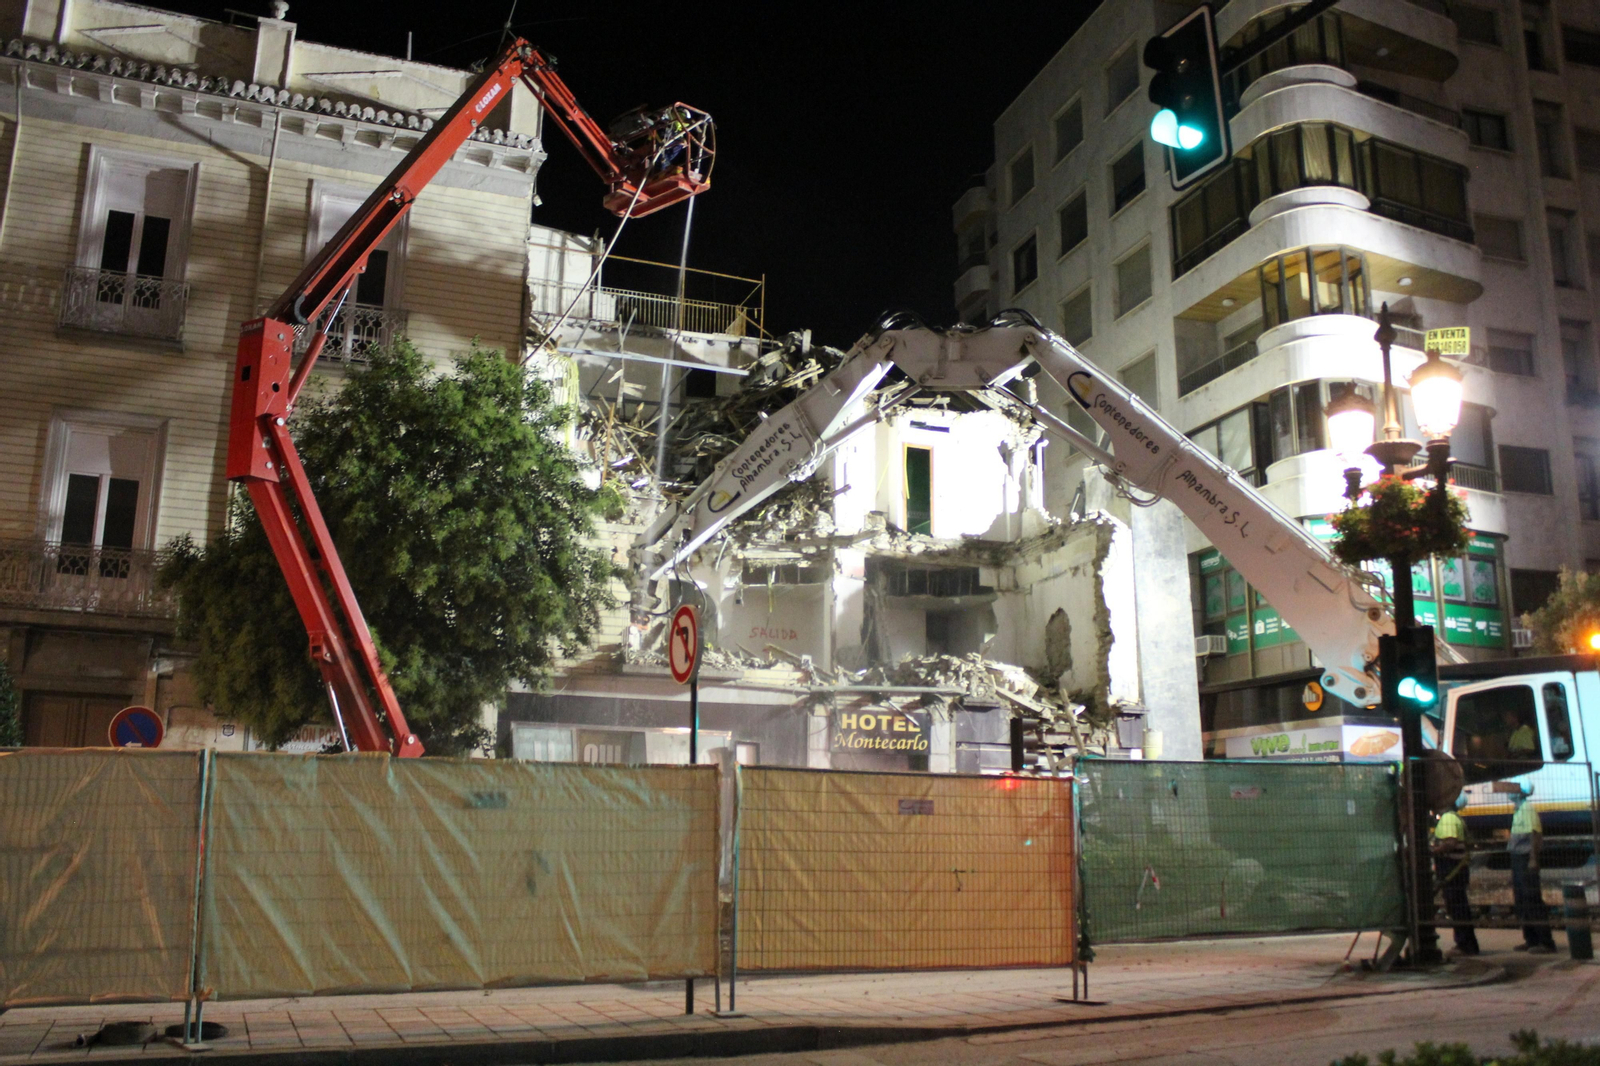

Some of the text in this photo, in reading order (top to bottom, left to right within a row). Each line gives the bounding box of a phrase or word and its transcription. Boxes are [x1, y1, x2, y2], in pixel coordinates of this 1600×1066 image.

[1428, 328, 1466, 340] EN VENTA
[1094, 393, 1161, 456] Contenedores
[731, 422, 791, 479] Contenedores
[748, 626, 799, 641] SALIDA
[841, 713, 921, 732] HOTEL
[833, 731, 929, 751] Montecarlo
